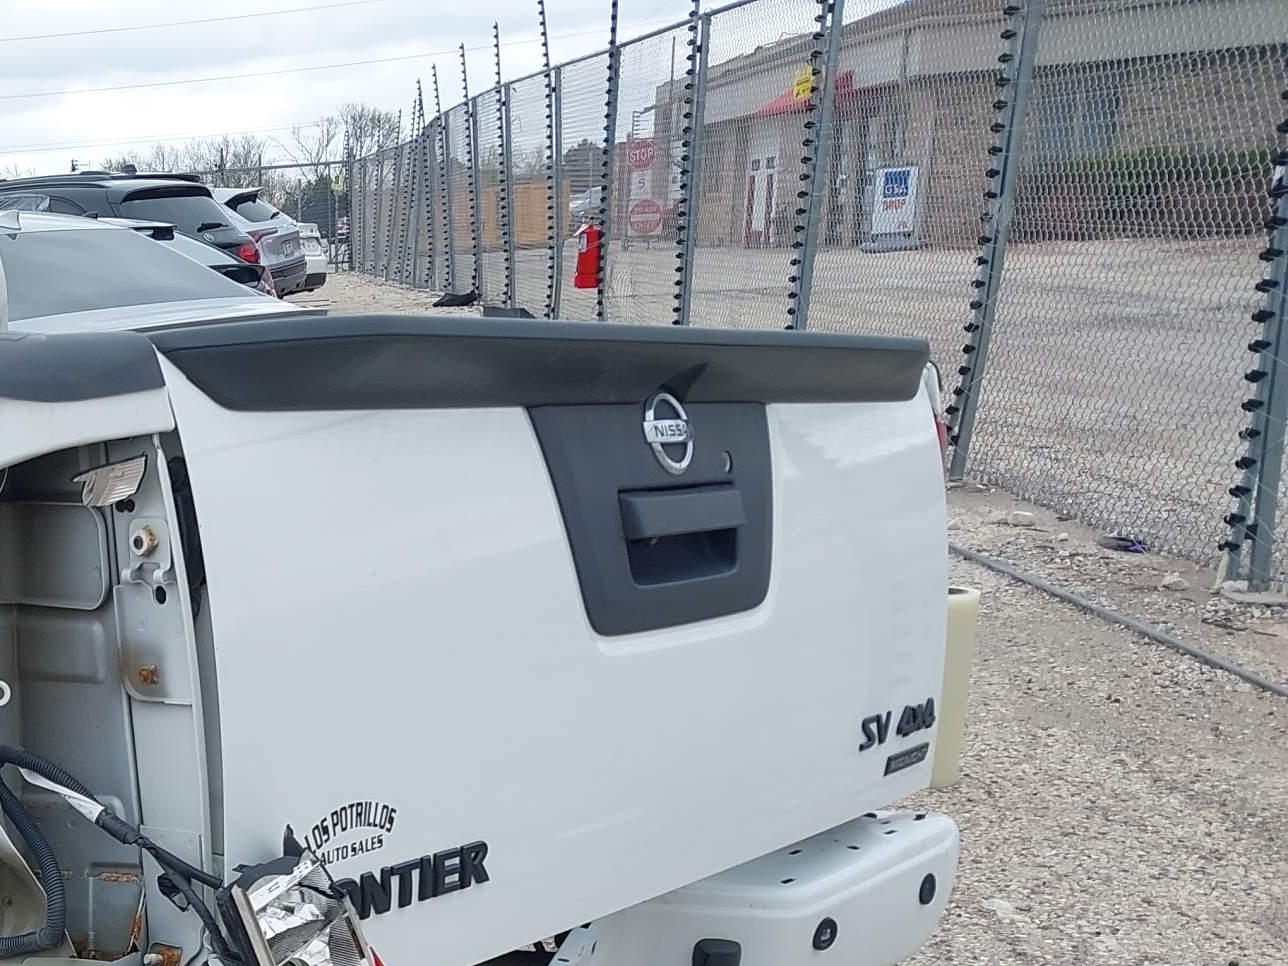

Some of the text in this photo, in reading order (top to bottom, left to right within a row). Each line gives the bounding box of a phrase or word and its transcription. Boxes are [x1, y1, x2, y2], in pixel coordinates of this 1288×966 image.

[629, 148, 654, 162] STOP
[654, 424, 688, 438] NISSA
[858, 710, 892, 752] SV
[303, 801, 397, 854] LOS POTRILLOS
[319, 833, 385, 866] AUTO SALES
[334, 840, 490, 921] ONTIER
